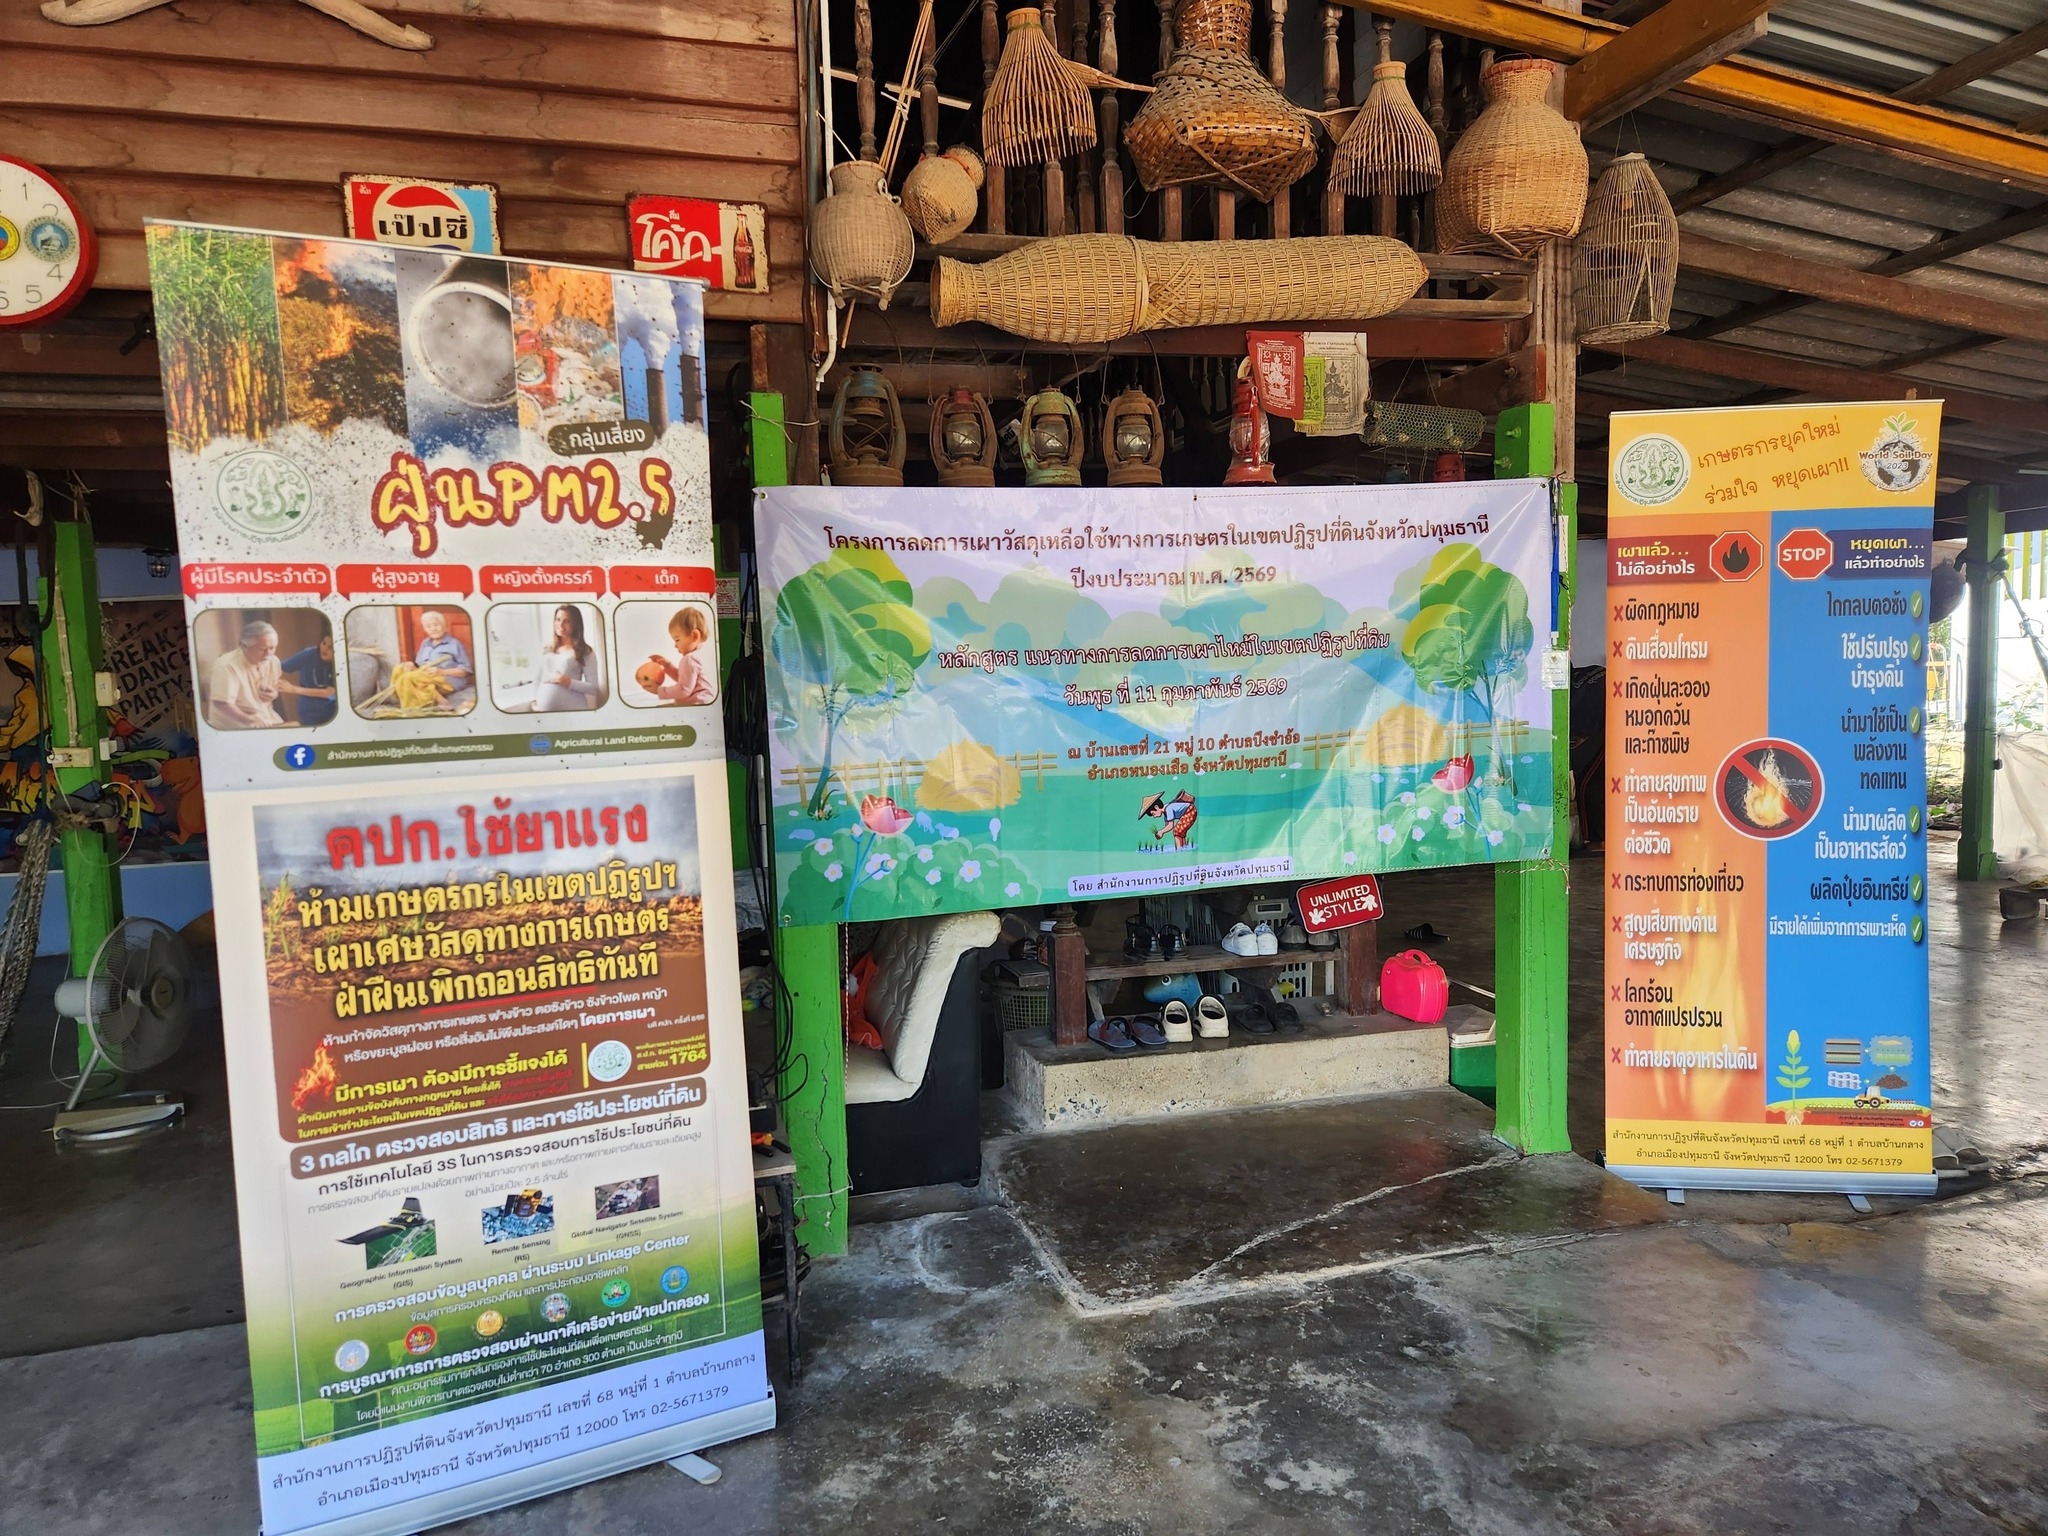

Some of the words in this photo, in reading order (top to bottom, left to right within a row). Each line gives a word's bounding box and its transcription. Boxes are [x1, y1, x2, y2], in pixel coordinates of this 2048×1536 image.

[635, 213, 712, 262] โค้ก
[25, 284, 43, 304] 5
[568, 420, 646, 452] กลุ่มเสี่ยง
[1697, 416, 1841, 469] เกษตรกรยุคใหม่
[1859, 451, 1889, 460] World
[1893, 451, 1911, 459] Soil
[1914, 451, 1933, 460] Day
[1887, 462, 1908, 470] 2023
[1704, 476, 1759, 506] ร่วมใจ
[1771, 457, 1850, 490] หยุดเผา!!
[823, 513, 1490, 557] โครงการลดการเผาวัสดุเหลือใช้ทางการเกษตรในเขตปฏิรูปที่ดินจังหวัดปทุมธานี
[1849, 536, 1925, 552] หยุดเผา...
[1617, 543, 1689, 558] เผาแล้ว...
[1782, 547, 1827, 563] STOP
[1844, 555, 1926, 571] แล้วทำอย่างไร
[190, 566, 327, 590] ผู้มีโรคประจำตัว
[371, 566, 440, 590] ผู้สูงอายุ
[493, 567, 593, 587] หญิงตั้งครรภ์
[655, 569, 679, 585] เด็ก
[1070, 567, 1185, 588] ปีงบประมาณ
[1189, 567, 1229, 585] พ.ศ.
[1233, 564, 1277, 584] 2569
[1616, 558, 1696, 578] ไม่ดีอย่างไร
[1625, 598, 1700, 627] ผิดกฎหมาย
[1827, 590, 1907, 617] ไถกลบตอซัง
[937, 643, 1018, 674] หลักสูตร
[1025, 622, 1390, 667] แนวทางการลดการเผาไหม้ในเขตปฏิรูปที่ดิน
[1625, 629, 1708, 660] ดินเสื่อมโทรม
[1841, 632, 1908, 665] ใช้ปรับปรุง
[1063, 682, 1112, 711] วันพุธ
[1115, 677, 1131, 705] ที่
[1135, 684, 1156, 704] 11
[1161, 675, 1242, 708] กุมภาพันธ์
[1245, 677, 1288, 698] 2569
[1625, 673, 1710, 704] เกิดฝุ่นละออง
[1851, 662, 1904, 695] บำรุงดิน
[1625, 703, 1691, 727] หมอกควัน
[1841, 704, 1907, 734] นำมาใช้เป็น
[554, 736, 603, 749] Agricultural
[604, 735, 625, 746] Land
[627, 734, 658, 744] Reform
[659, 732, 684, 742] Office
[1067, 745, 1081, 760] ณ
[1085, 734, 1150, 759] บ้านเลขที่
[1153, 740, 1170, 755] 21
[1174, 735, 1194, 757] หมู่
[1197, 736, 1215, 751] 10
[1218, 728, 1301, 751] ตำบลบึงชำอ้อ
[1625, 729, 1690, 754] และก๊าซพิษ
[1853, 736, 1907, 762] พลังงาน
[1087, 757, 1189, 781] อำเภอหนองเสือ
[1192, 749, 1288, 774] จังหวัดปทุมธานี
[1624, 768, 1707, 800] ทำลายสุขภาพ
[1860, 771, 1907, 790] ทดแทน
[1624, 795, 1699, 824] เป็นอันตราย
[1843, 807, 1906, 832] นำมาผลิต
[325, 797, 649, 872] คปก.ใช้ยาแรง
[1624, 831, 1671, 856] ต่อชีวิต
[1814, 837, 1907, 860] เป็นอาหารสัตว์
[1072, 878, 1093, 893] โดย
[1096, 859, 1291, 892] สำนักงานการปฏิรูปที่ดินจังหวัดปทุมธานี
[1624, 862, 1744, 892] กระทบการท่องเที่ยว
[1810, 874, 1909, 907] ผลิตปุ๋ยอินทรีย์
[297, 860, 678, 929] ห้ามเกษตรกรในเขตปฏิรูปฯ
[1309, 884, 1371, 908] UNLIMITED
[1323, 898, 1364, 919] STYLE
[1624, 907, 1717, 939] สูญเสียทางด้าน
[1769, 912, 1907, 938] มีรายได้เพิ่มจากการเพาะเห็ด
[313, 903, 670, 975] เผาเศษวัสดุทางการเกษตร
[1624, 936, 1682, 966] เศรษฐกิจ
[334, 940, 660, 1020] ฝ่าฝืนเพิกถอนสิทธิทันที
[1625, 977, 1673, 1004] โลกร้อน
[323, 1012, 487, 1047] ห้ามกำจัดวัสดุทางการเกษตร
[488, 1003, 532, 1023] ฟางข้าว
[642, 987, 668, 1001] หญ้า
[1624, 1006, 1723, 1028] อากาศแปรปรวน
[344, 1039, 433, 1064] หรือขยะมูลฝอย
[580, 1006, 656, 1027] โดยการเผา
[669, 1048, 708, 1065] 1764
[1624, 1042, 1758, 1075] ทำลายธาตุอาหารในดิน
[334, 1076, 418, 1103] มีการเผา
[421, 1048, 569, 1088] ต้องมีการชี้แจงได้
[300, 1155, 316, 1173] 3
[319, 1143, 371, 1170] กลไก
[376, 1117, 508, 1157] ตรวจสอบสิทธิ
[512, 1086, 701, 1133] และการใช้ประโยชน์ที่ดิน
[1612, 1129, 1780, 1147] สำนักงานการปฏิรูปที่ดินจังหวัดปทุมธานี
[1782, 1131, 1807, 1147] เลขที่
[1809, 1137, 1822, 1147] 68
[1824, 1134, 1845, 1150] หมู่ที่
[1848, 1138, 1854, 1148] 1
[1857, 1136, 1925, 1152] ตำบลบ้านกลาง
[318, 1160, 433, 1196] การใช้เทคโนโลยี
[437, 1158, 458, 1171] 3S
[460, 1114, 692, 1169] ในการตรวจสอบการใช้ประโยชน์ที่ดิน
[1636, 1147, 1720, 1163] อำเภอเมืองปทุมธานี
[1723, 1148, 1791, 1165] จังหวัดปทุมธานี
[1794, 1154, 1824, 1165] 12000
[1826, 1153, 1843, 1165] โทร
[1846, 1157, 1903, 1167] 02-5671379
[335, 1270, 519, 1323] การตรวจสอบข้อมูลบุคคล
[521, 1256, 584, 1282] ผ่านระบบ
[587, 1243, 641, 1266] Linkage
[643, 1234, 690, 1253] Center
[541, 1363, 553, 1374] 70
[582, 1353, 601, 1365] 300
[272, 1401, 552, 1490] สำนักงานการปฏิรูปที่ดินจังหวัดปทุมธานี
[557, 1389, 592, 1414] เลขที่
[597, 1390, 614, 1403] 68
[618, 1375, 648, 1399] หมู่ที่
[653, 1377, 661, 1389] 1
[666, 1352, 756, 1385] ตำบลบ้านกลาง
[317, 1456, 460, 1507] อำเภอเมืองปทุมธานี
[465, 1425, 570, 1468] จังหวัดปทุมธานี
[576, 1417, 619, 1436] 12000
[622, 1407, 646, 1424] โทร
[651, 1386, 729, 1416] 02-5671379
